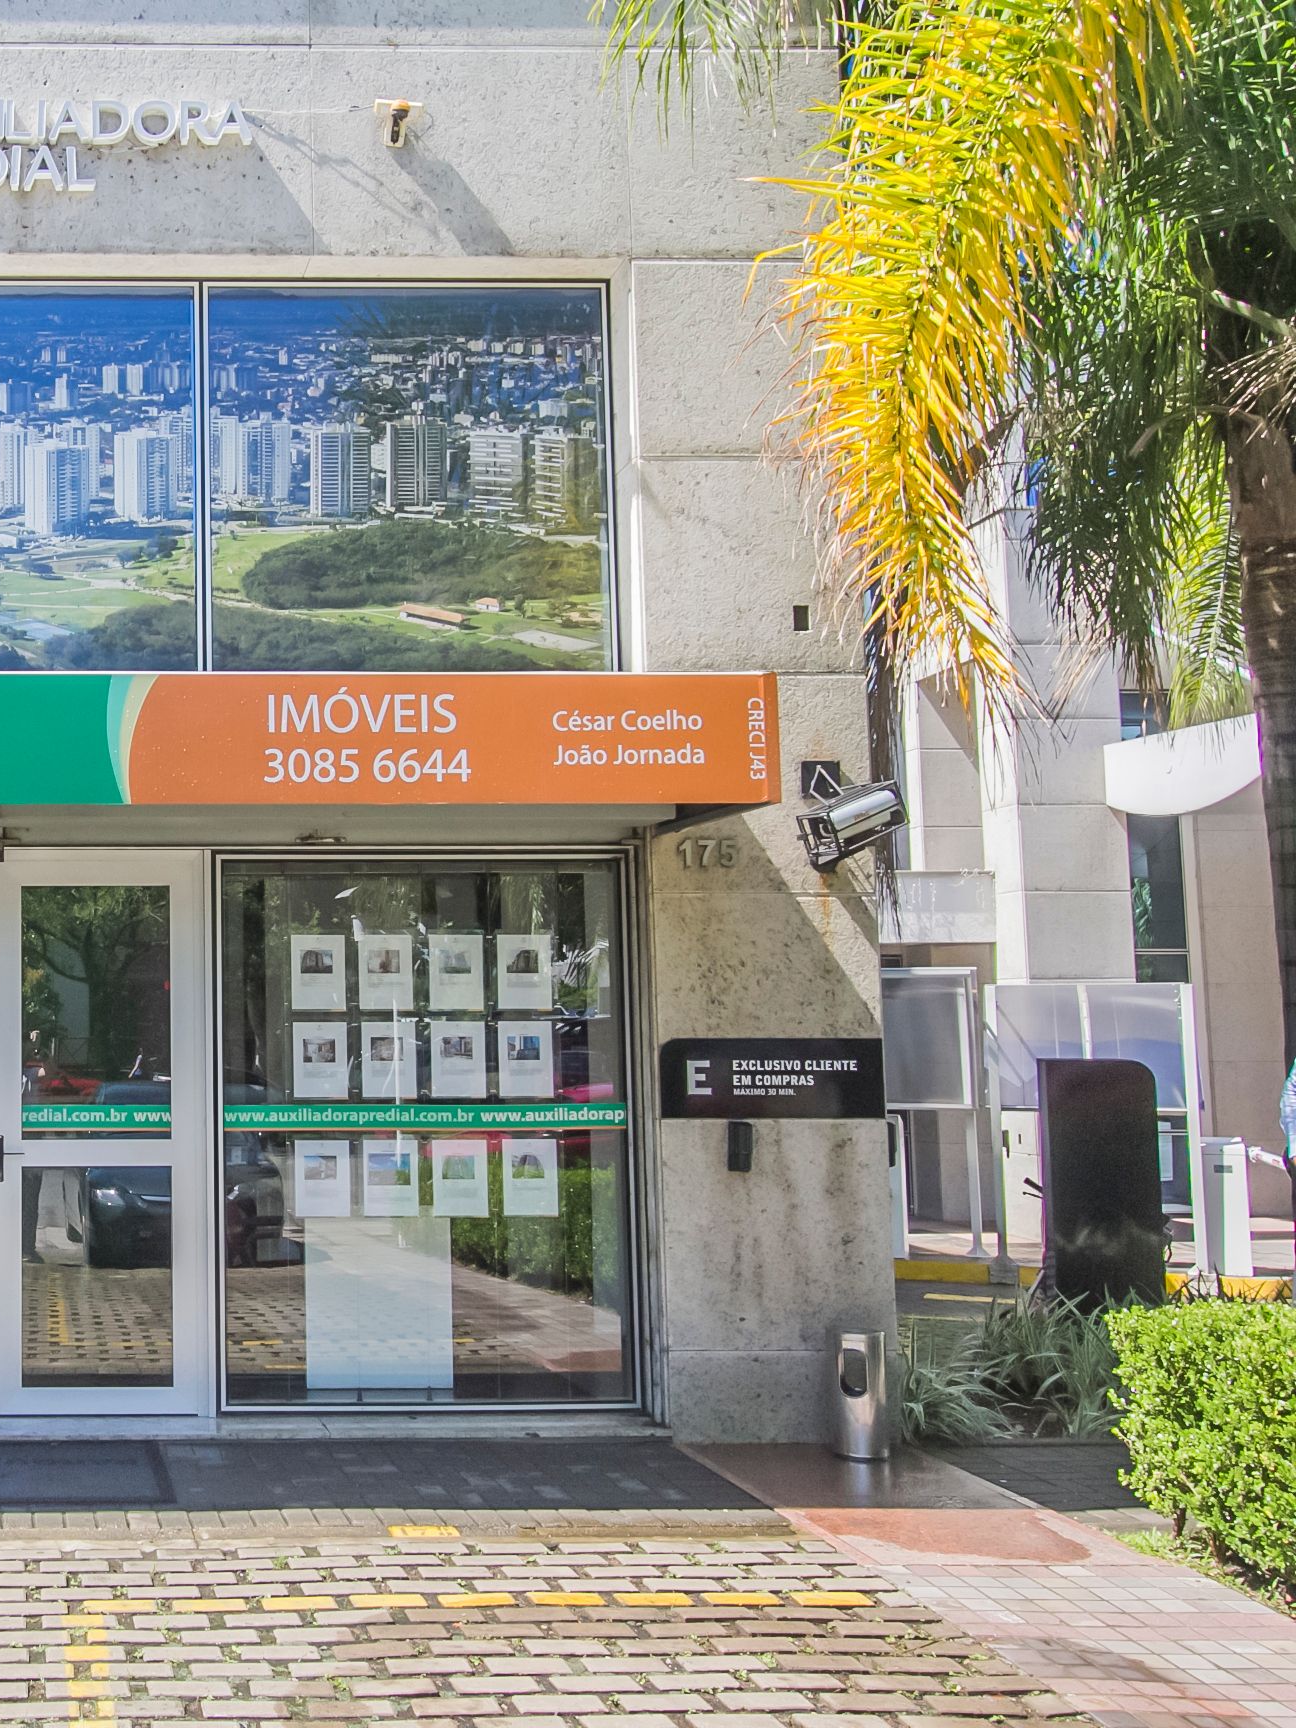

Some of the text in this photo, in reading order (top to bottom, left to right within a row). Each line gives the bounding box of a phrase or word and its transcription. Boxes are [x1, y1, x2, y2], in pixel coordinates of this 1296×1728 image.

[268, 687, 457, 733] IMÓVEIS
[552, 709, 703, 731] César Coelho
[747, 698, 767, 780] CRECI J43
[553, 743, 705, 765] João Jornada
[264, 748, 471, 783] 3085 6644
[677, 837, 740, 869] 175
[732, 1060, 858, 1071] EXCLUSIVO CLIENTE
[687, 1060, 712, 1095] E
[733, 1075, 815, 1086] EM COMPRAS
[733, 1087, 796, 1096] MÁXIMO 30 MIN.
[22, 1108, 127, 1122] redial.com.br
[224, 1106, 625, 1125] www.auxiliadorapredial.com.br www.auxiliadorap
